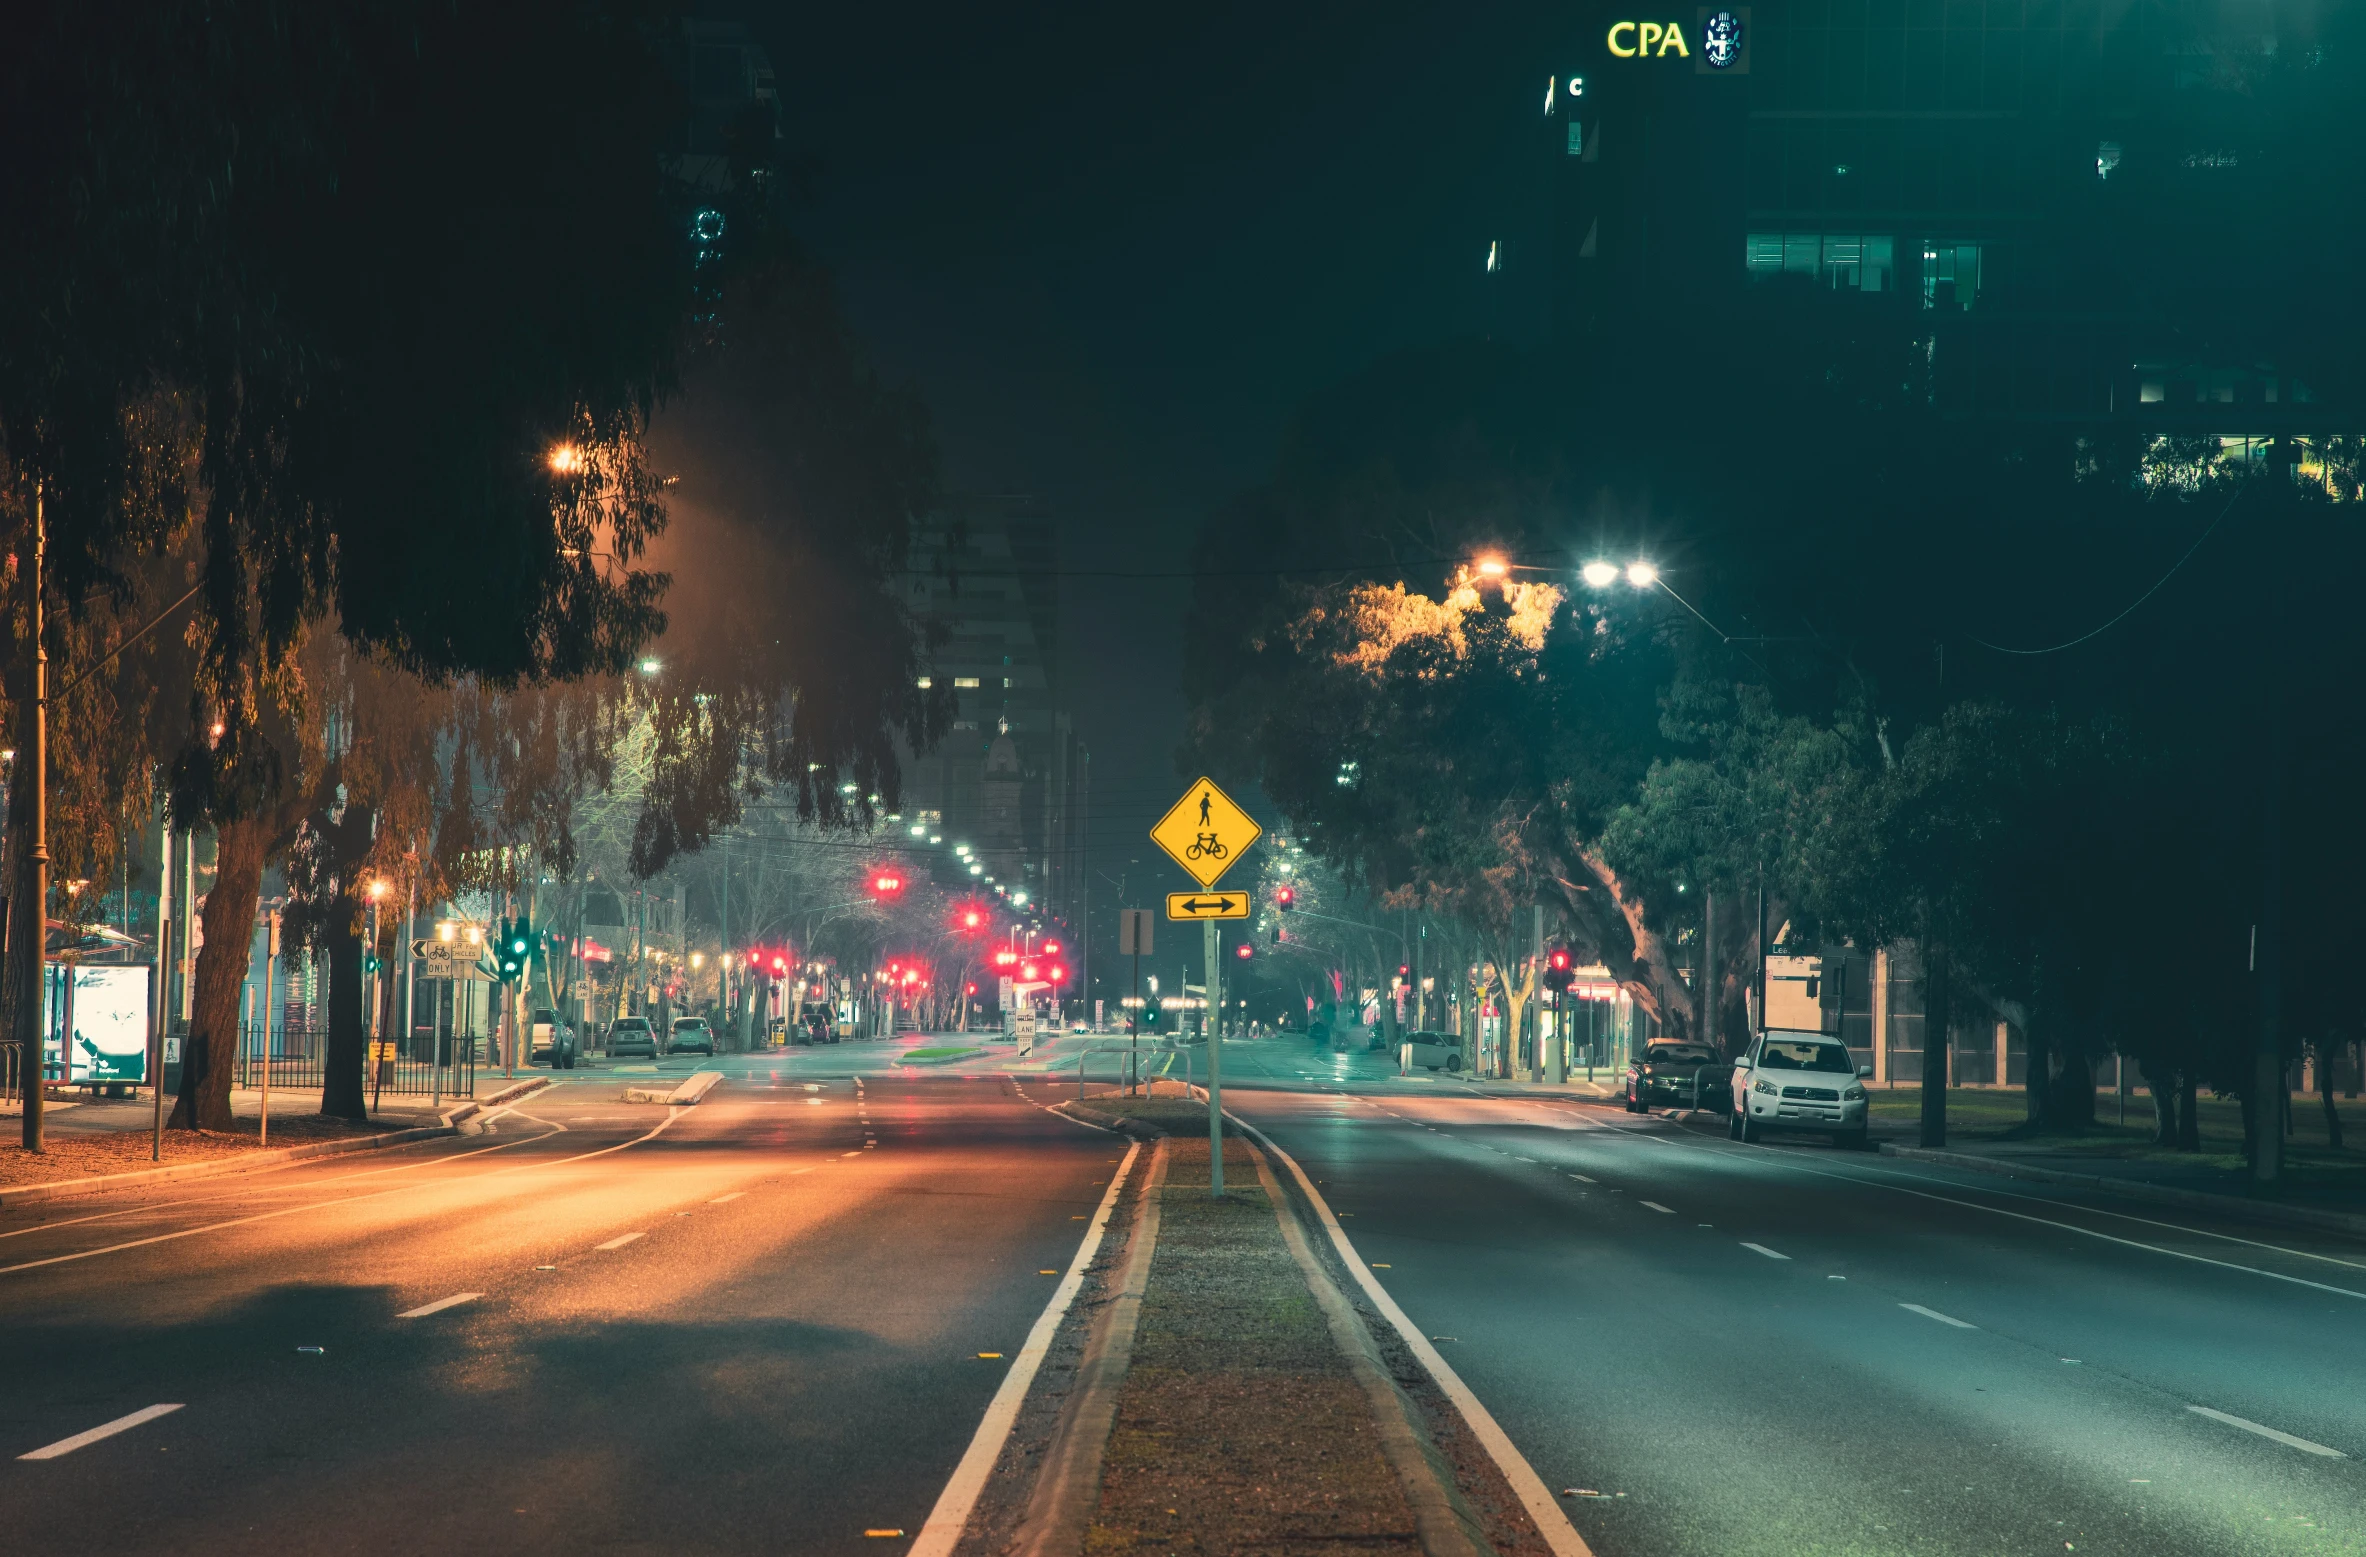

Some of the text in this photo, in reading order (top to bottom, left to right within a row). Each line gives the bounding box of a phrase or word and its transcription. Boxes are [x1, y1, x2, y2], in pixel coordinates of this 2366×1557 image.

[1607, 21, 1690, 58] CPA
[1708, 54, 1739, 67] INTEGRITY
[428, 965, 449, 973] ONLY
